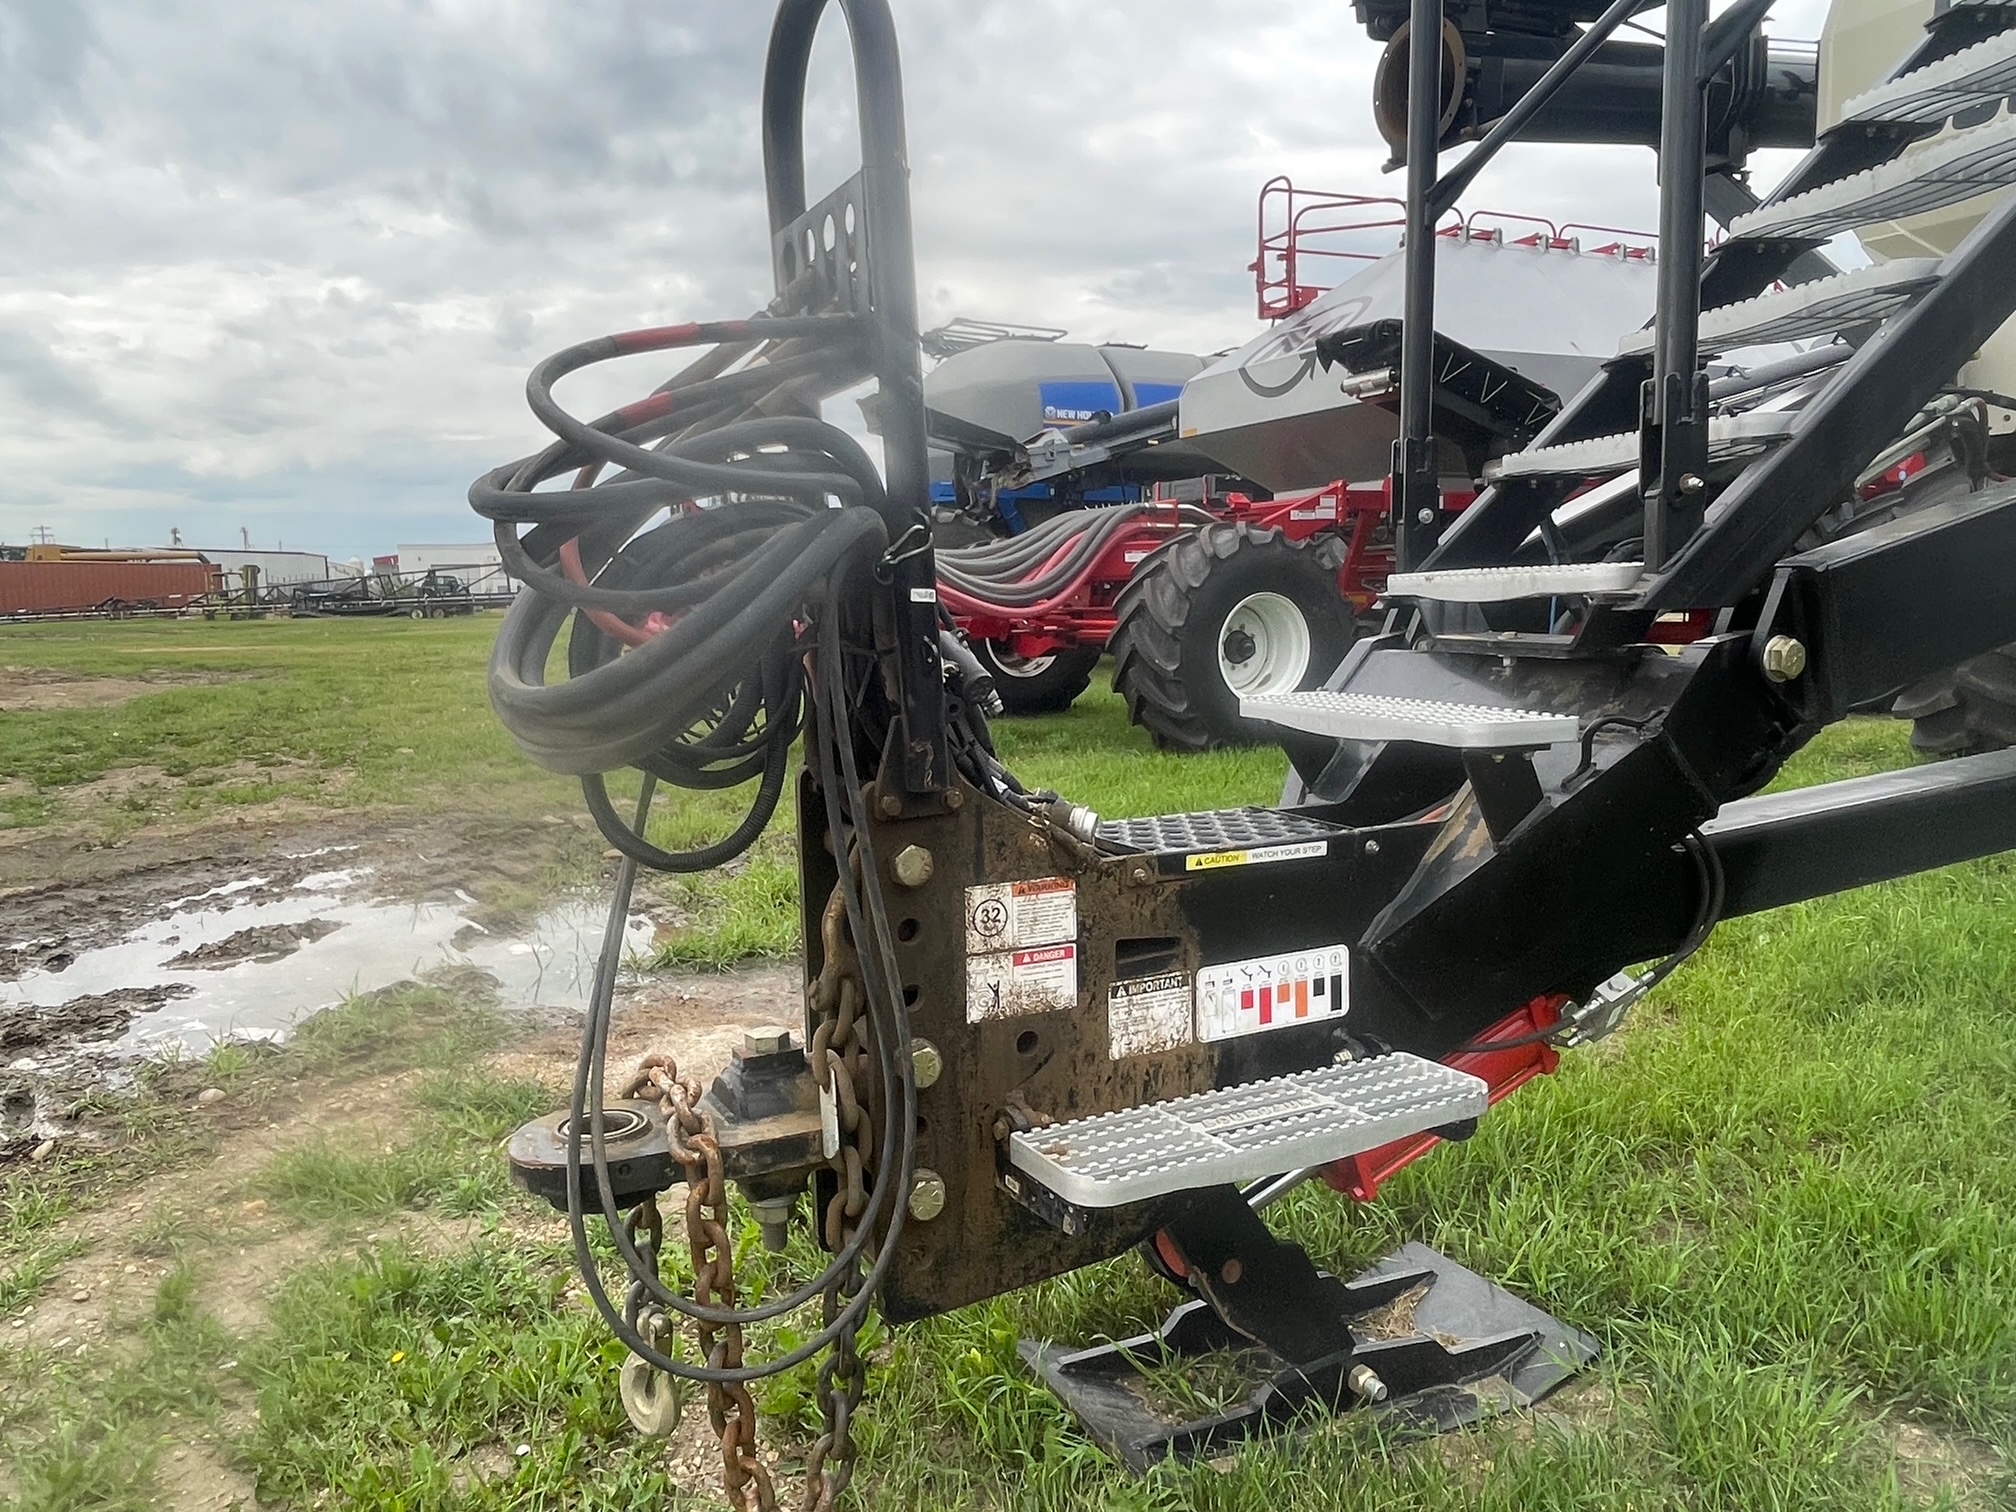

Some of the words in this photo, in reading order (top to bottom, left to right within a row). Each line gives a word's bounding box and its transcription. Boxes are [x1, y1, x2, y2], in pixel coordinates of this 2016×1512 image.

[1056, 409, 1076, 419] NEW
[1203, 854, 1240, 865] CAUTION
[1251, 850, 1279, 860] WATCH
[1280, 847, 1301, 857] YOUR
[1302, 845, 1322, 855] STEP
[980, 907, 1001, 924] 32
[1033, 949, 1066, 962] DANGER
[1128, 976, 1183, 995] IMPORTANT
